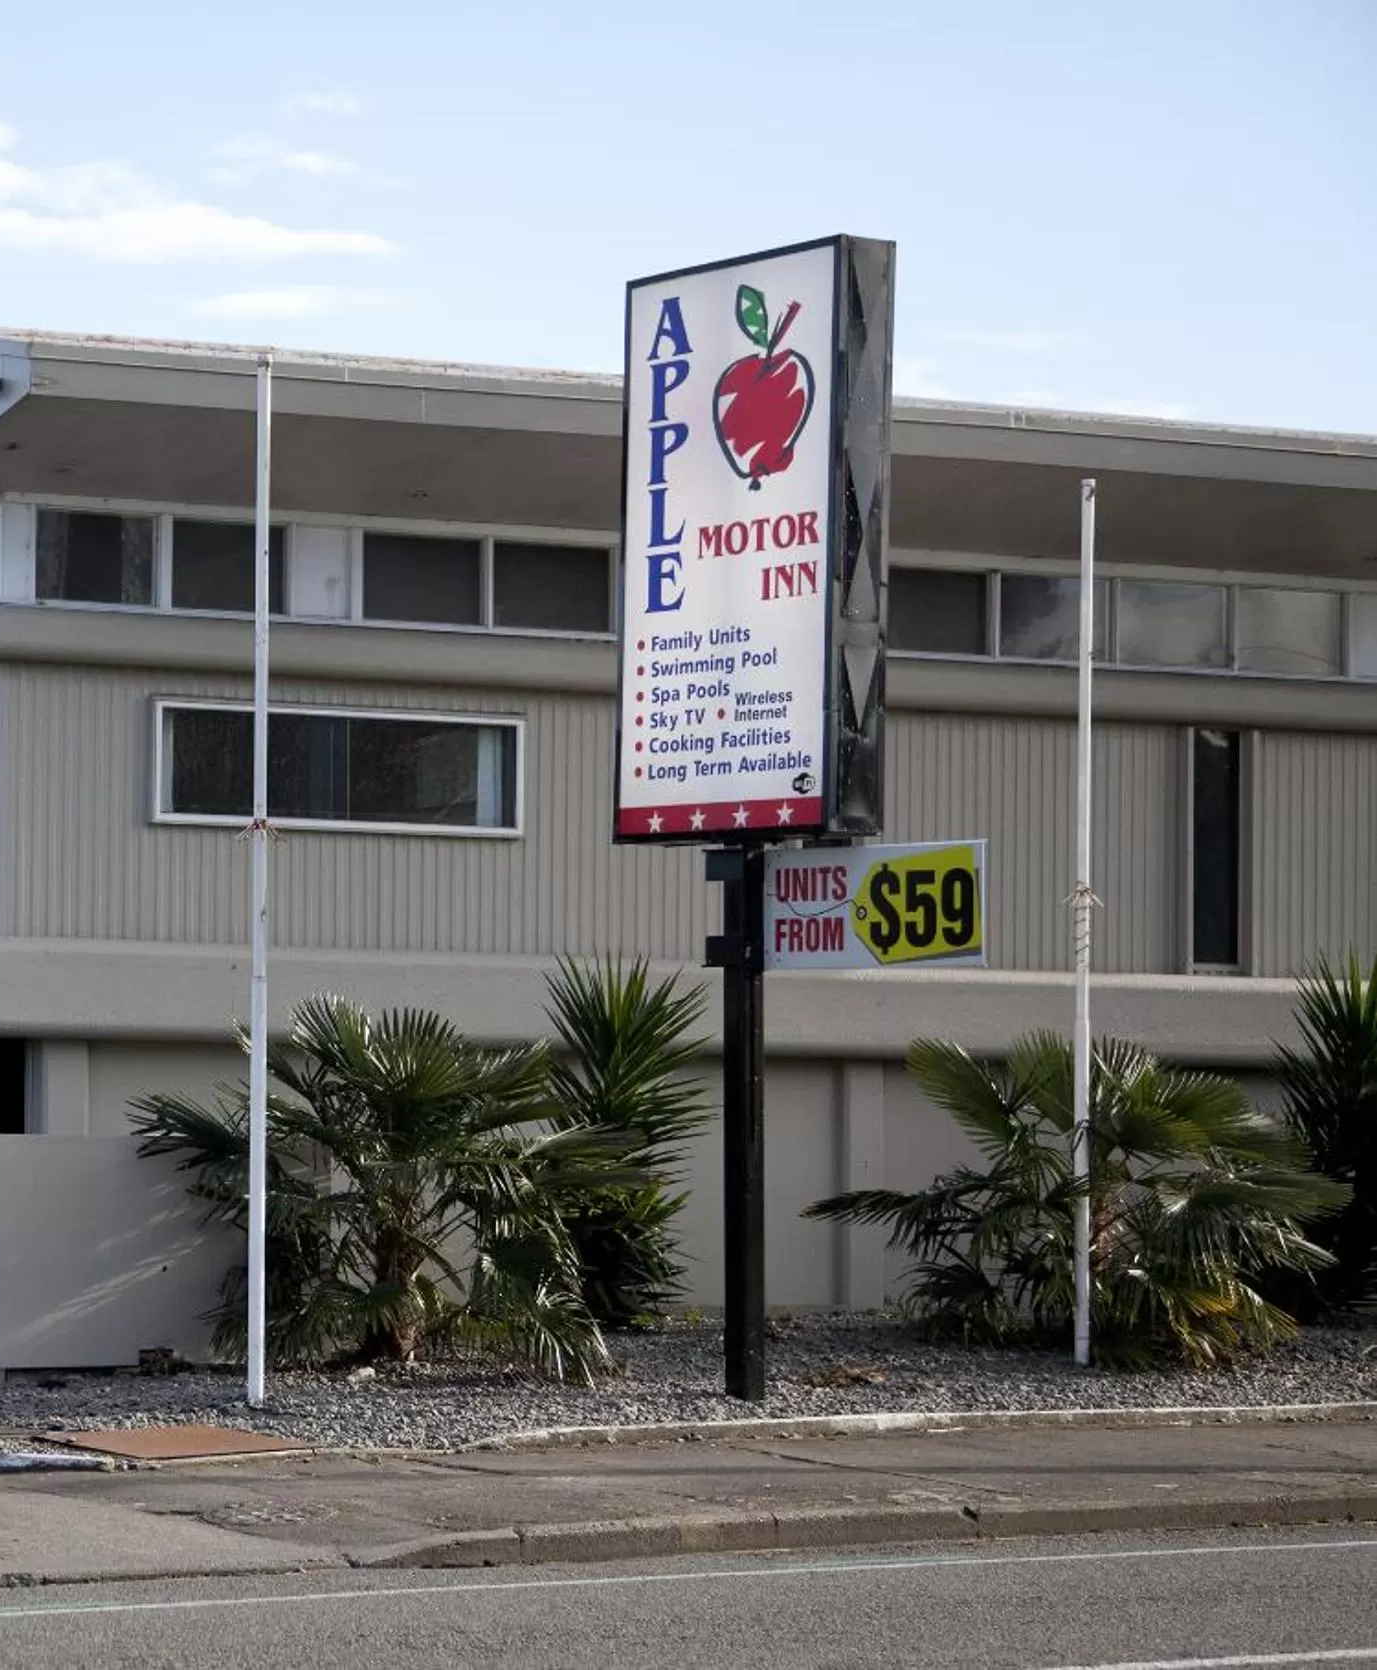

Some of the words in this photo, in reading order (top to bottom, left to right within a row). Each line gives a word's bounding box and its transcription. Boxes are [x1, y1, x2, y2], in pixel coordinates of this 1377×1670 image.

[644, 296, 694, 614] APPLE
[697, 511, 820, 560] MOTOR
[760, 560, 819, 601] INN
[651, 631, 702, 652] Family
[709, 625, 751, 645] Units
[651, 654, 735, 678] Swimming
[741, 647, 777, 668] Pool
[651, 687, 680, 706] Spa
[687, 680, 730, 700] Pools
[734, 690, 793, 706] Wireless
[650, 712, 678, 731] Sky
[685, 708, 706, 726] TV
[734, 705, 787, 722] Internet
[649, 735, 714, 754] Cooking
[721, 728, 791, 748] Facilities
[648, 764, 687, 782] Long
[694, 760, 732, 776] Term
[738, 751, 812, 773] Available
[775, 865, 847, 901] UNITS
[870, 863, 974, 955] $59
[775, 917, 844, 953] FROM
